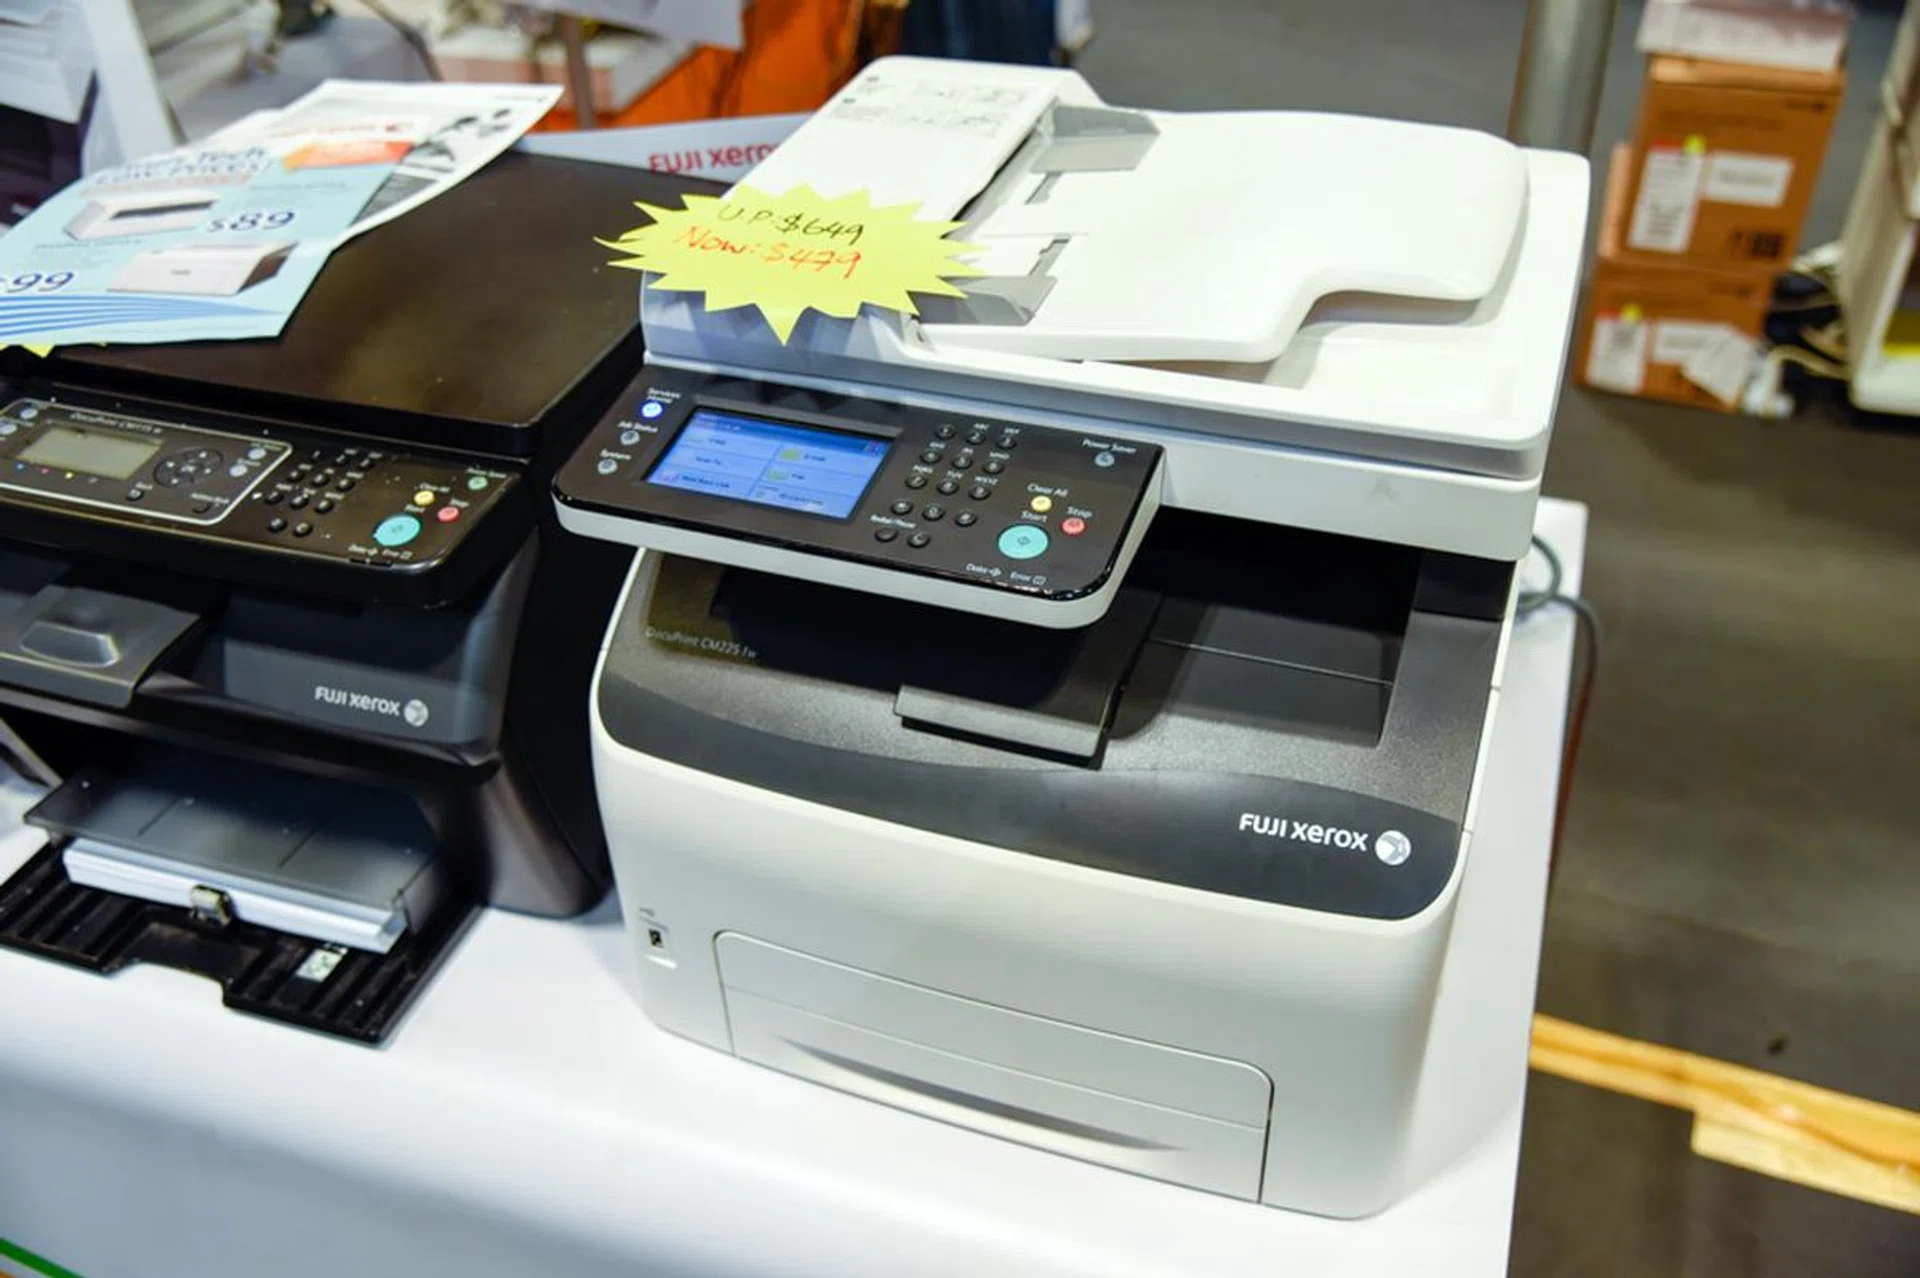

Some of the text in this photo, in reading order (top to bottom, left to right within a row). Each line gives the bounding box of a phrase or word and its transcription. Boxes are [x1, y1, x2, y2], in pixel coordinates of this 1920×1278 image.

[649, 151, 703, 175] FUJI
[1026, 482, 1053, 495] Clear
[1020, 509, 1049, 523] Start
[1066, 506, 1093, 520] Stop
[315, 685, 401, 717] FUJI xerox
[1238, 812, 1369, 852] FUJI xerox
